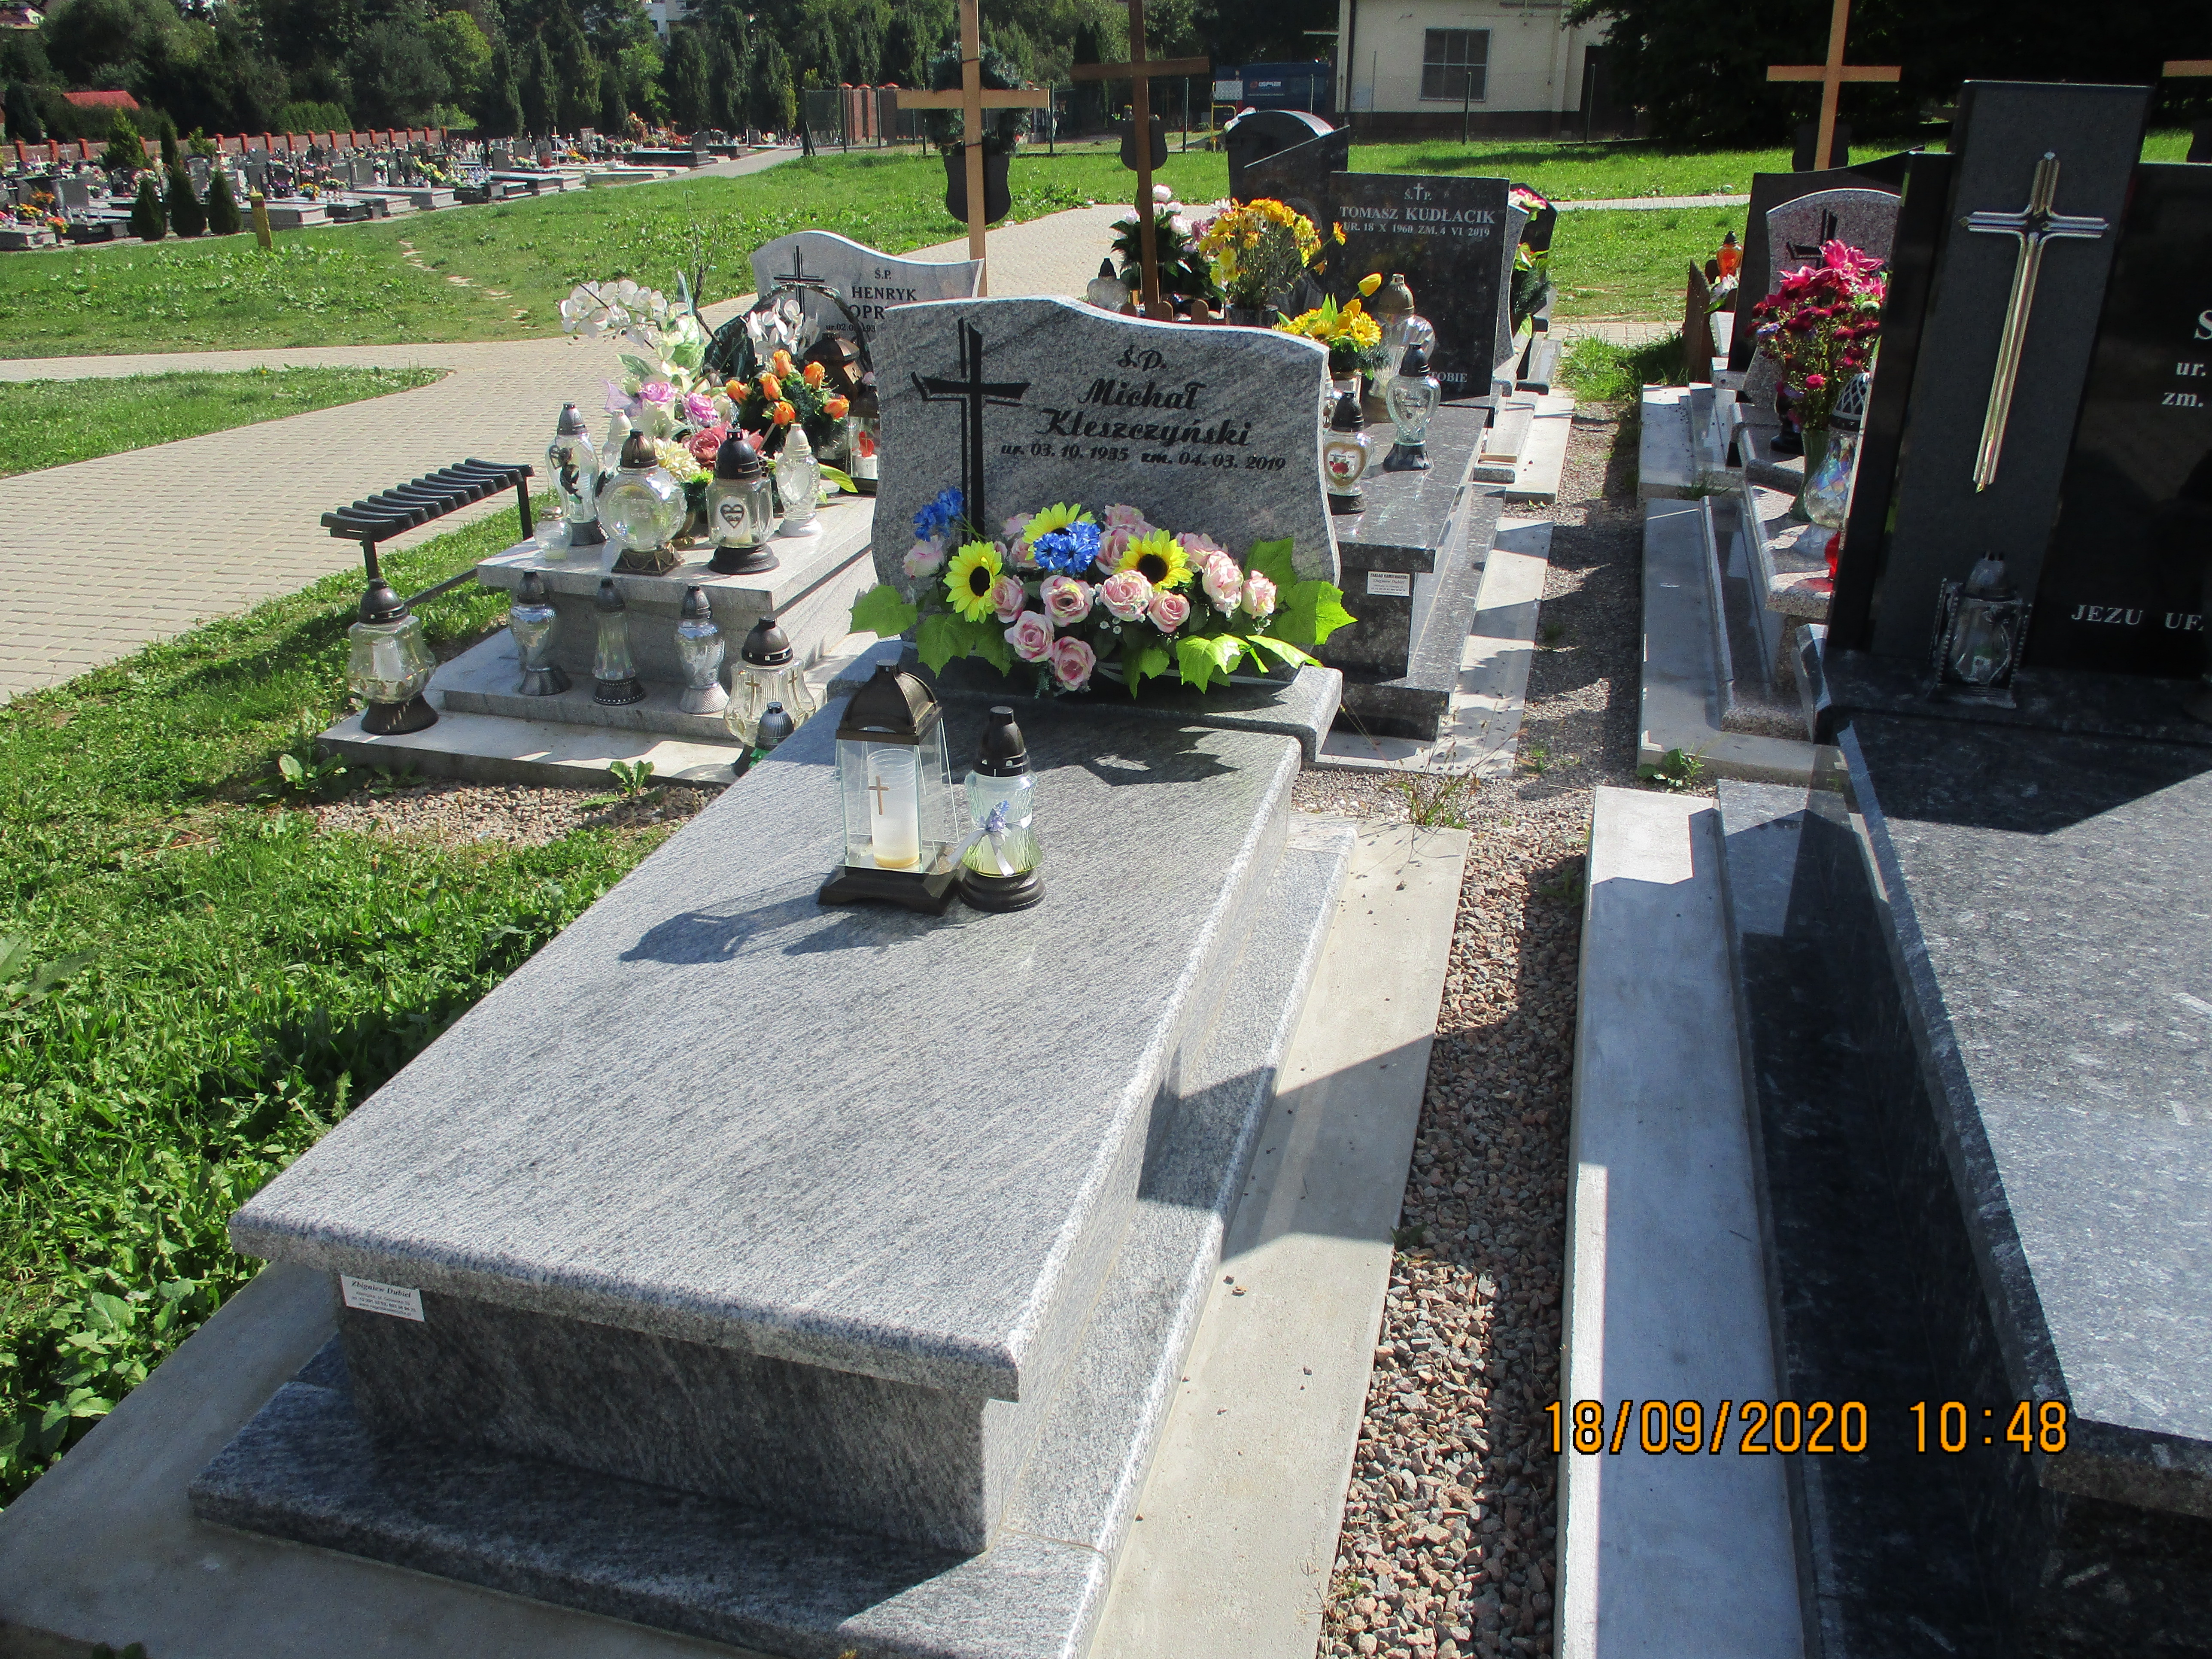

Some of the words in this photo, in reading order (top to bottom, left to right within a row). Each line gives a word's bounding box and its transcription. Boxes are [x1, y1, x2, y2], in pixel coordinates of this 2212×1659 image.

[1340, 206, 1399, 219] TOMASZ
[1405, 207, 1495, 224] KUDŁACIK
[1343, 222, 1360, 231] UR.
[1364, 223, 1373, 231] 18
[1378, 224, 1387, 233] X
[1392, 224, 1413, 234] 1960
[1418, 225, 1437, 235] ZM.
[1451, 227, 1463, 236] VI
[1468, 227, 1490, 237] 2019
[851, 286, 917, 301] HENRYK
[2175, 362, 2207, 377] ur.
[1078, 378, 1206, 410] Michał
[2161, 392, 2204, 407] zm.
[1035, 408, 1251, 447] Kleszczyński
[1001, 444, 1025, 455] ur.
[1030, 443, 1055, 456] 03.
[1061, 444, 1084, 458] 10.
[1141, 452, 1173, 464] zm.
[1179, 452, 1206, 466] 04.
[1212, 453, 1238, 468] 03.
[1245, 455, 1285, 471] 2019
[2071, 605, 2144, 625] JEZU
[2164, 612, 2205, 631] UF
[387, 1288, 412, 1298] Dubiel
